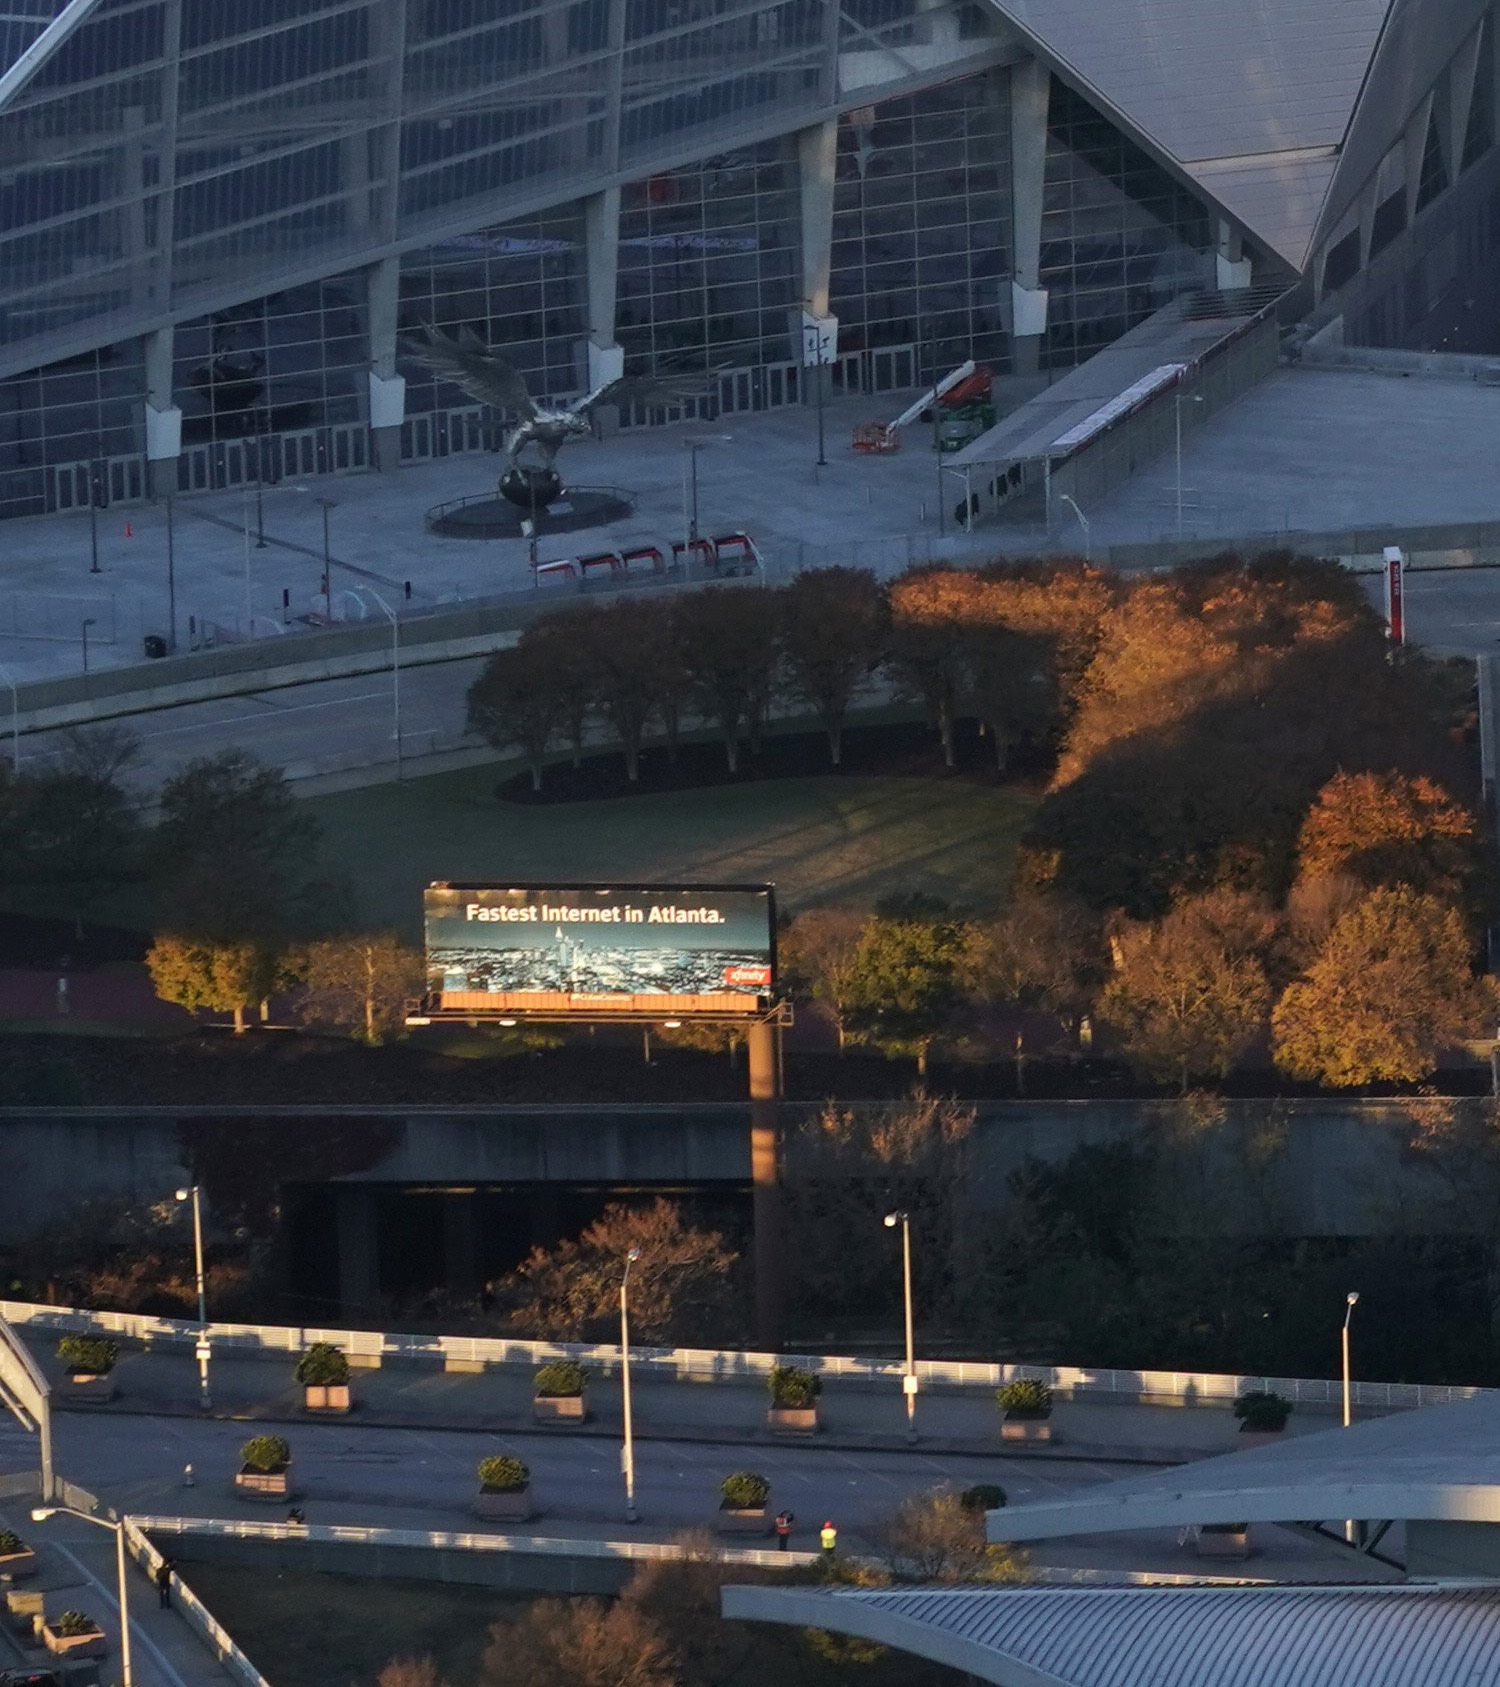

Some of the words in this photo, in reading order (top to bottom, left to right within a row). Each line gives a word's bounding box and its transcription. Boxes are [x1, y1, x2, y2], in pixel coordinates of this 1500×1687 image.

[466, 904, 537, 922] Fastest
[542, 904, 620, 922] Internet
[625, 904, 643, 922] in
[648, 905, 726, 923] Atlanta.
[730, 968, 766, 983] xfinity
